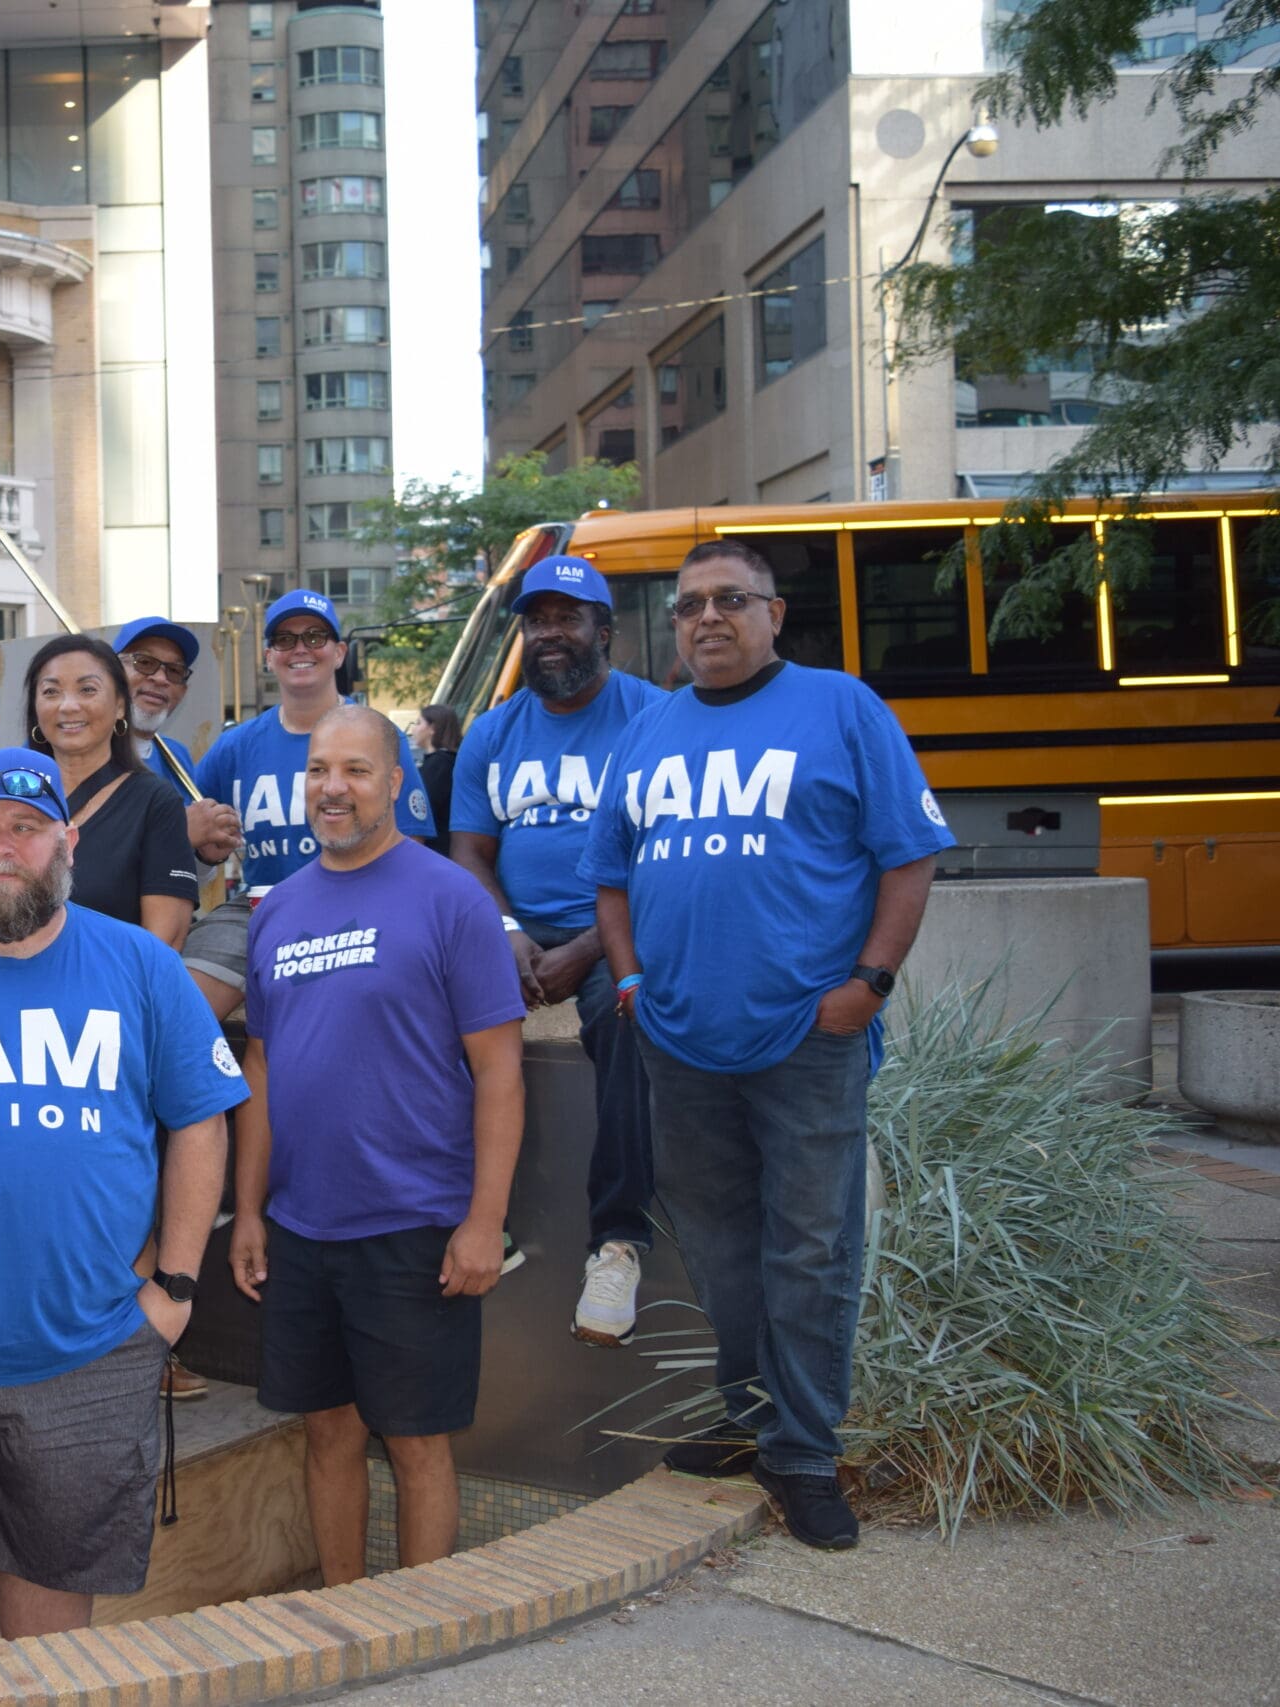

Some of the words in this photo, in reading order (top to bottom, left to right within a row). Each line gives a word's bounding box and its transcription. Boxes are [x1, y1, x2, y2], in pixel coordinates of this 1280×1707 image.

[556, 566, 584, 579] IAM
[303, 595, 328, 611] IAM
[487, 752, 612, 822] IAM
[625, 748, 797, 831] IAM
[276, 927, 377, 962] WORKERS
[273, 946, 377, 980] TOGETHER
